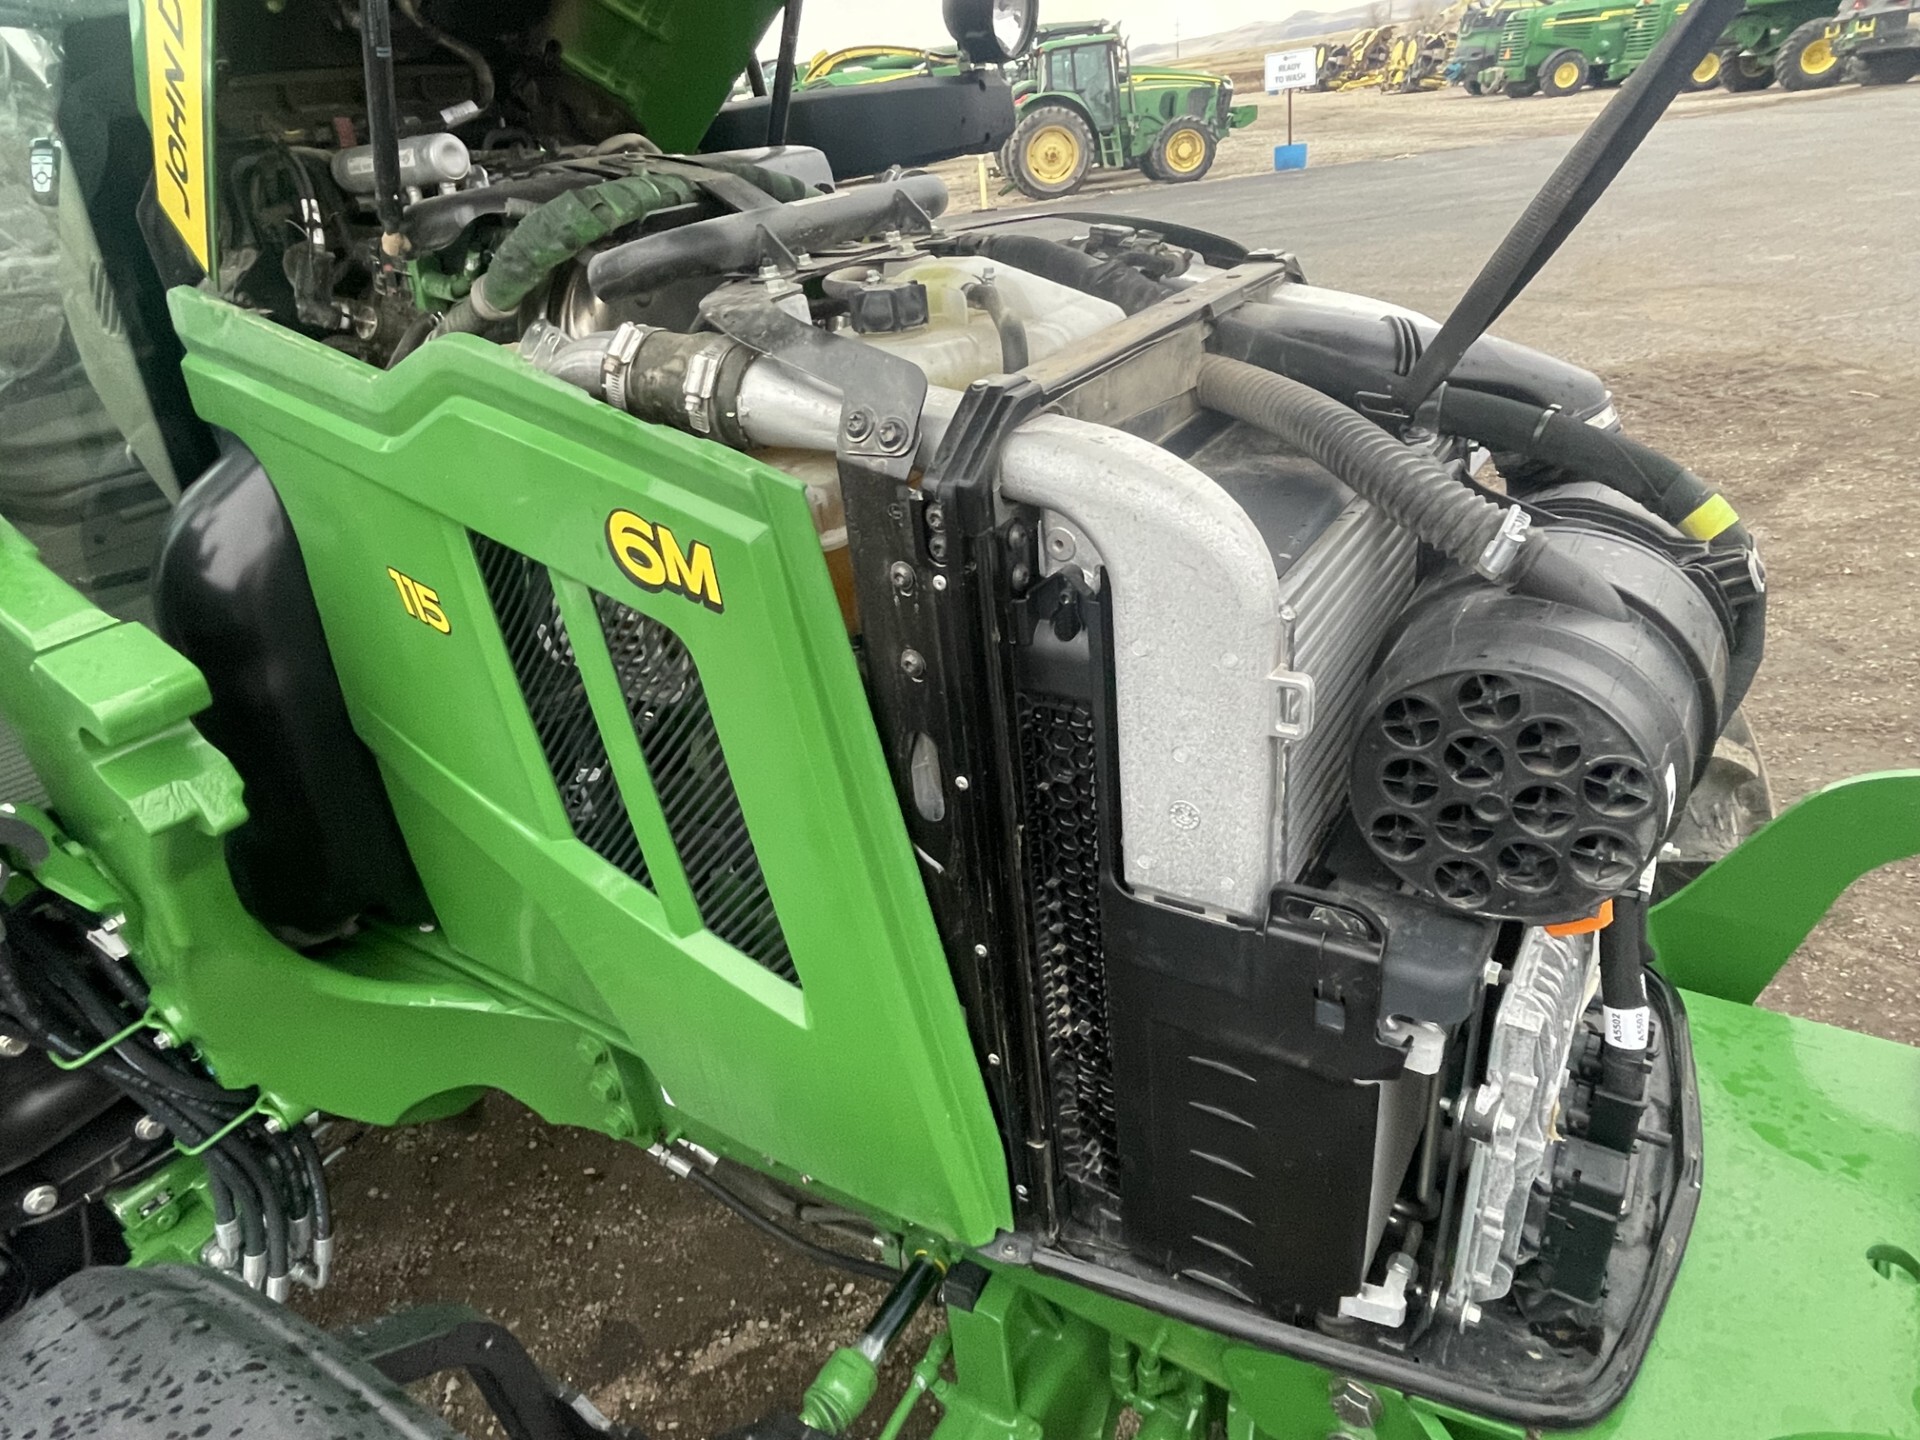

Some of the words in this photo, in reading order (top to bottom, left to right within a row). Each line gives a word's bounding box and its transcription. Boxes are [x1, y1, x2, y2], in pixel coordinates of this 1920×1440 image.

[1278, 62, 1301, 72] READY
[1285, 73, 1306, 82] WASH
[164, 39, 190, 220] JOHN
[604, 507, 725, 614] 6M
[386, 565, 452, 636] 115
[1611, 1013, 1622, 1043] A5502
[1635, 1013, 1645, 1041] A5502
